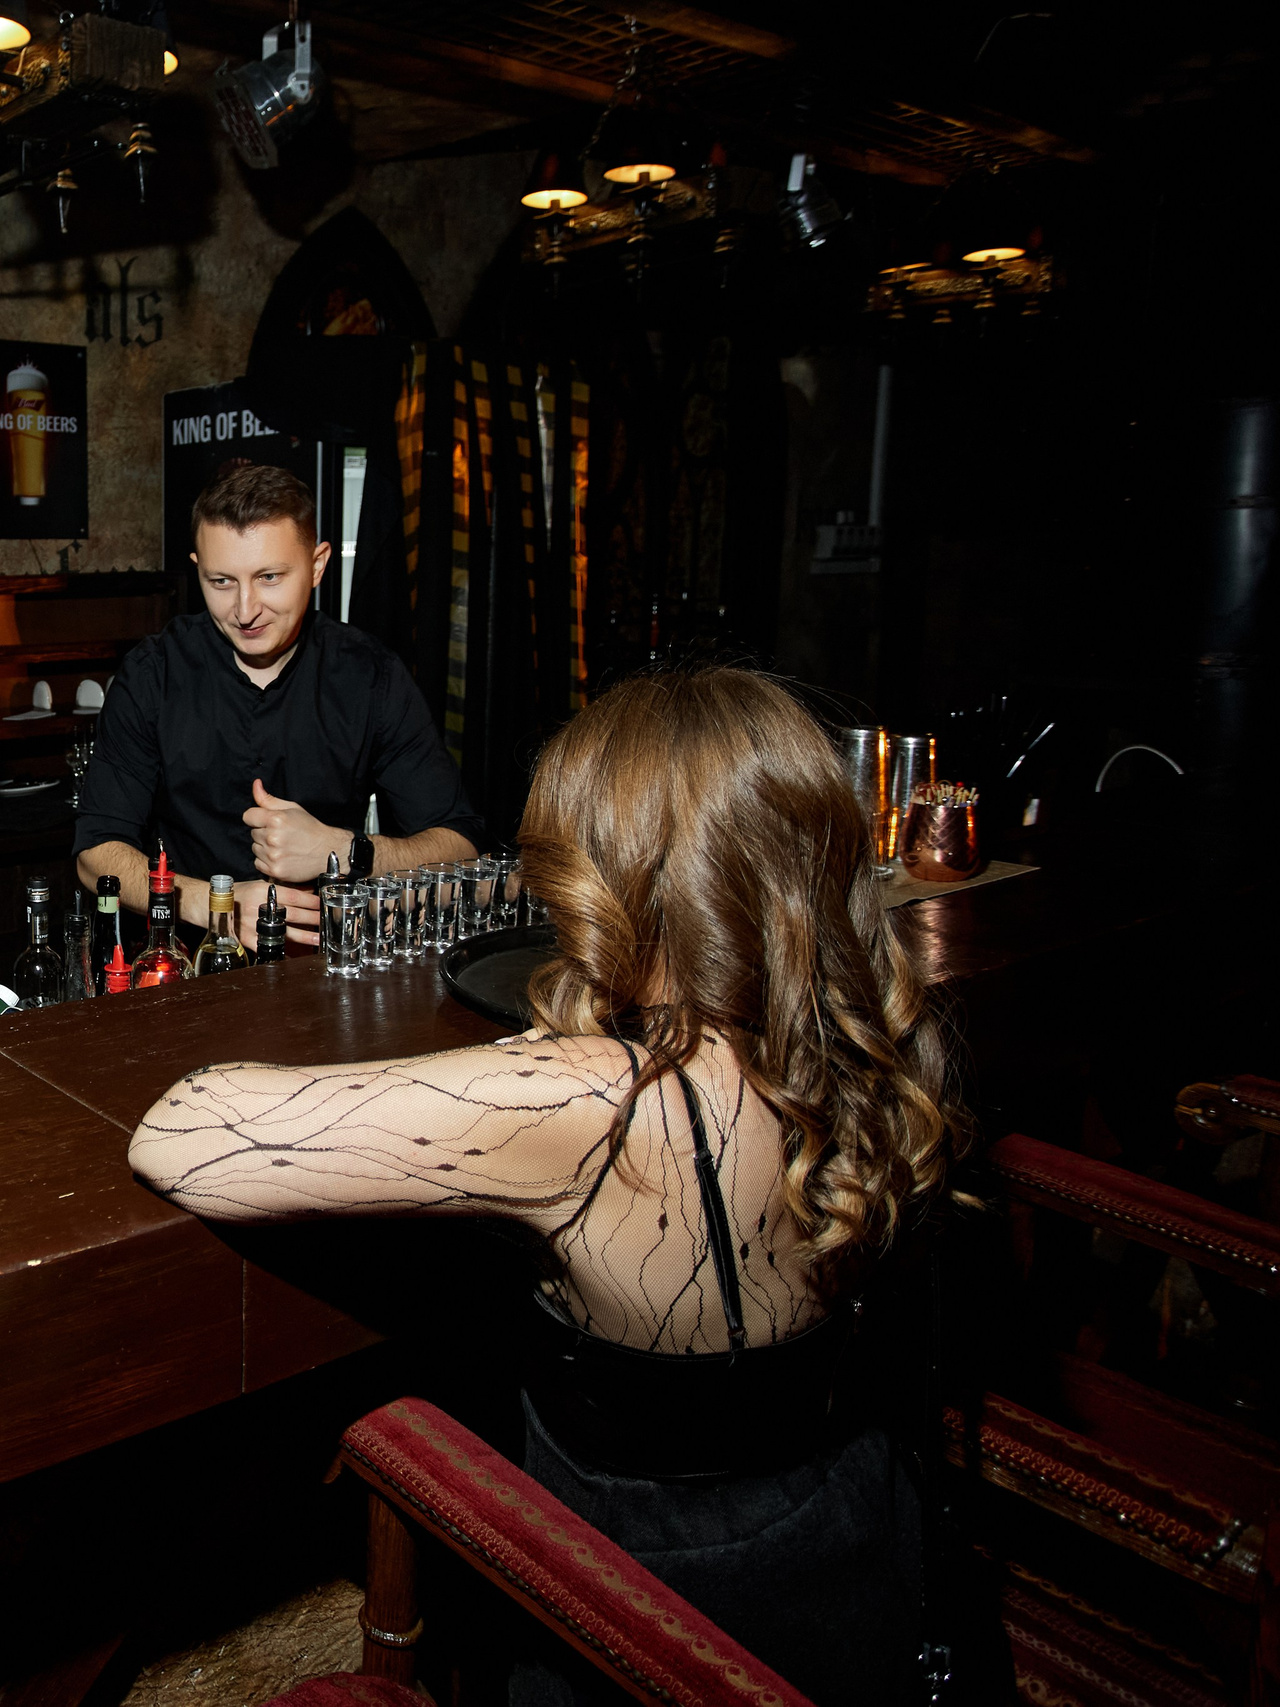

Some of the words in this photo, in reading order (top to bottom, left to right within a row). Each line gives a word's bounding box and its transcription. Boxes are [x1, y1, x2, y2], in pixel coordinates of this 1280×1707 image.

[17, 414, 33, 430] OF
[37, 415, 78, 433] BEERS
[172, 414, 212, 446] KING
[215, 410, 239, 441] OF
